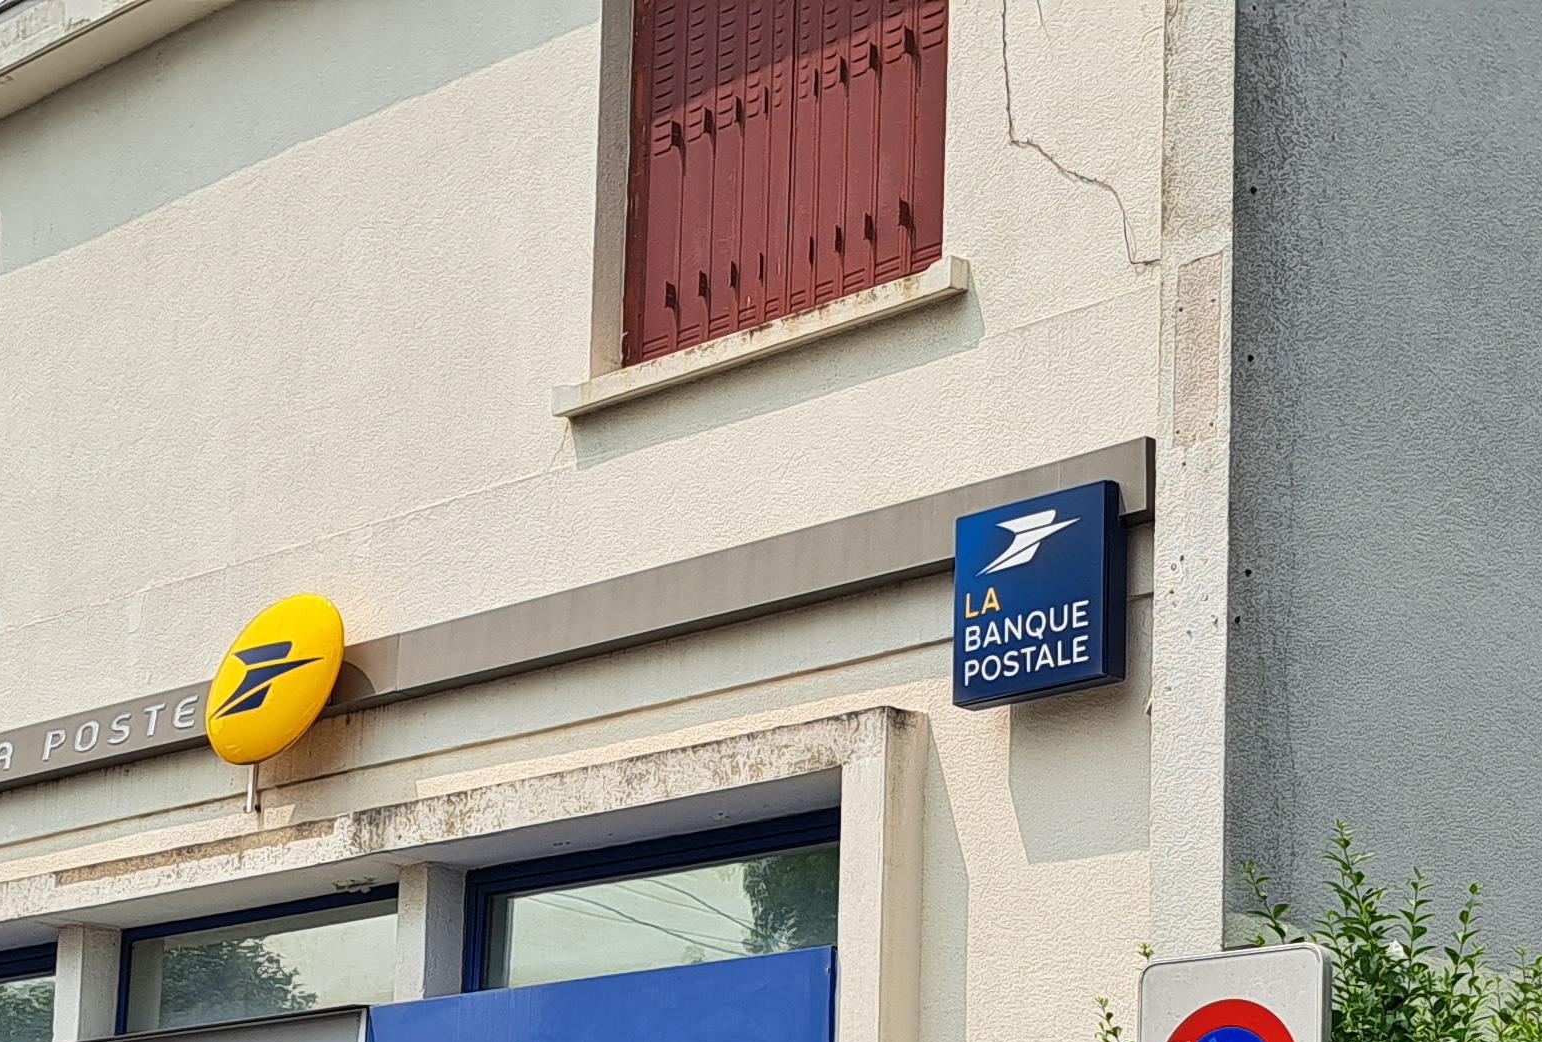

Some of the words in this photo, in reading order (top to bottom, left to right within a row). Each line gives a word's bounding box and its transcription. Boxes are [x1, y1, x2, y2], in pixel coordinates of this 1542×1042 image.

[965, 587, 1000, 618] LA
[965, 600, 1090, 652] BANQUE
[964, 635, 1090, 686] POSTALE
[42, 695, 199, 761] POSTE
